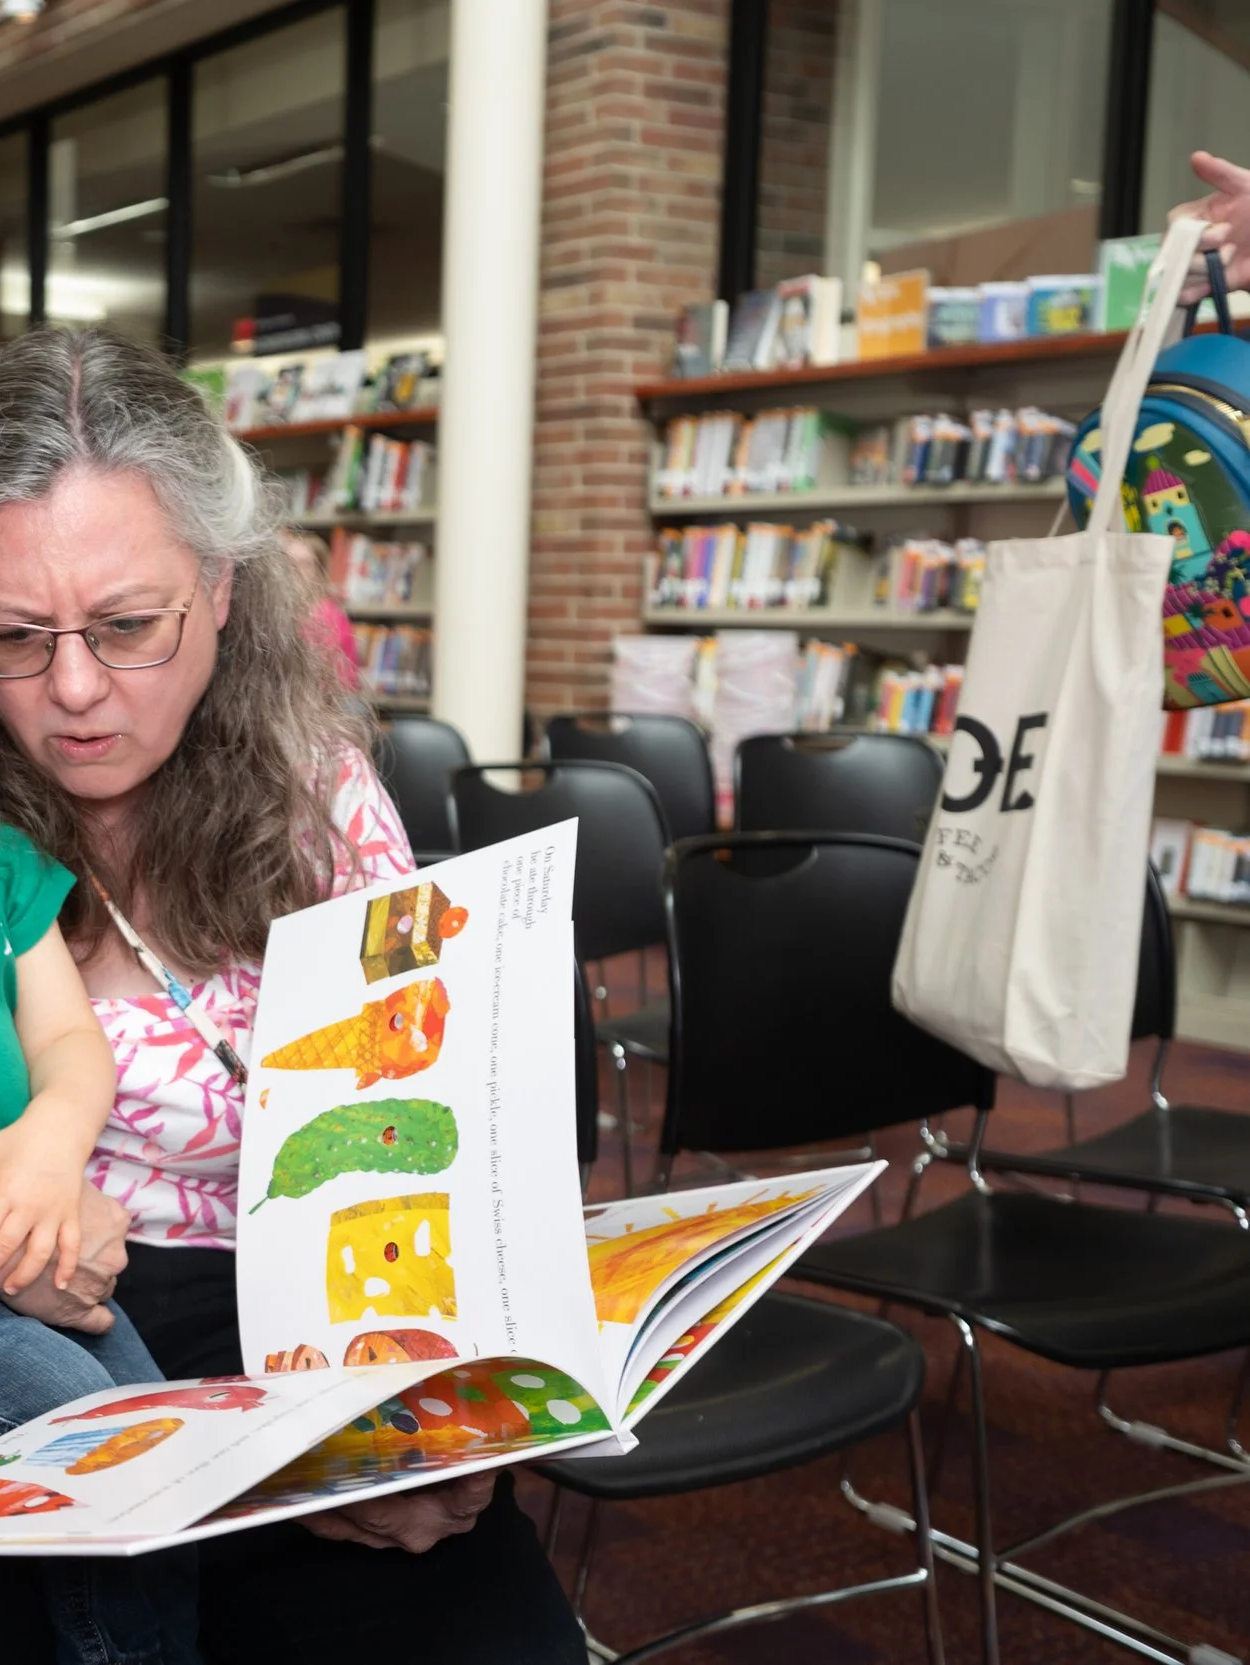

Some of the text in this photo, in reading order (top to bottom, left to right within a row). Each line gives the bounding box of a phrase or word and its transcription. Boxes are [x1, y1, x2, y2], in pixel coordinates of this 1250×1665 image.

[500, 860, 514, 910] chocolate
[511, 855, 525, 920] one piece of
[523, 850, 542, 930] he ate through
[536, 845, 556, 914] On Saturday
[495, 912, 509, 941] cake,
[494, 942, 502, 963] one
[490, 1055, 498, 1077] one
[486, 1081, 501, 1121] pickle,
[489, 1123, 497, 1146] one
[490, 1150, 502, 1178] slice
[491, 1181, 503, 1193] of
[493, 1200, 505, 1235] Swiss
[495, 1238, 507, 1285] cheese,
[501, 1287, 510, 1312] one
[504, 1315, 517, 1345] slice
